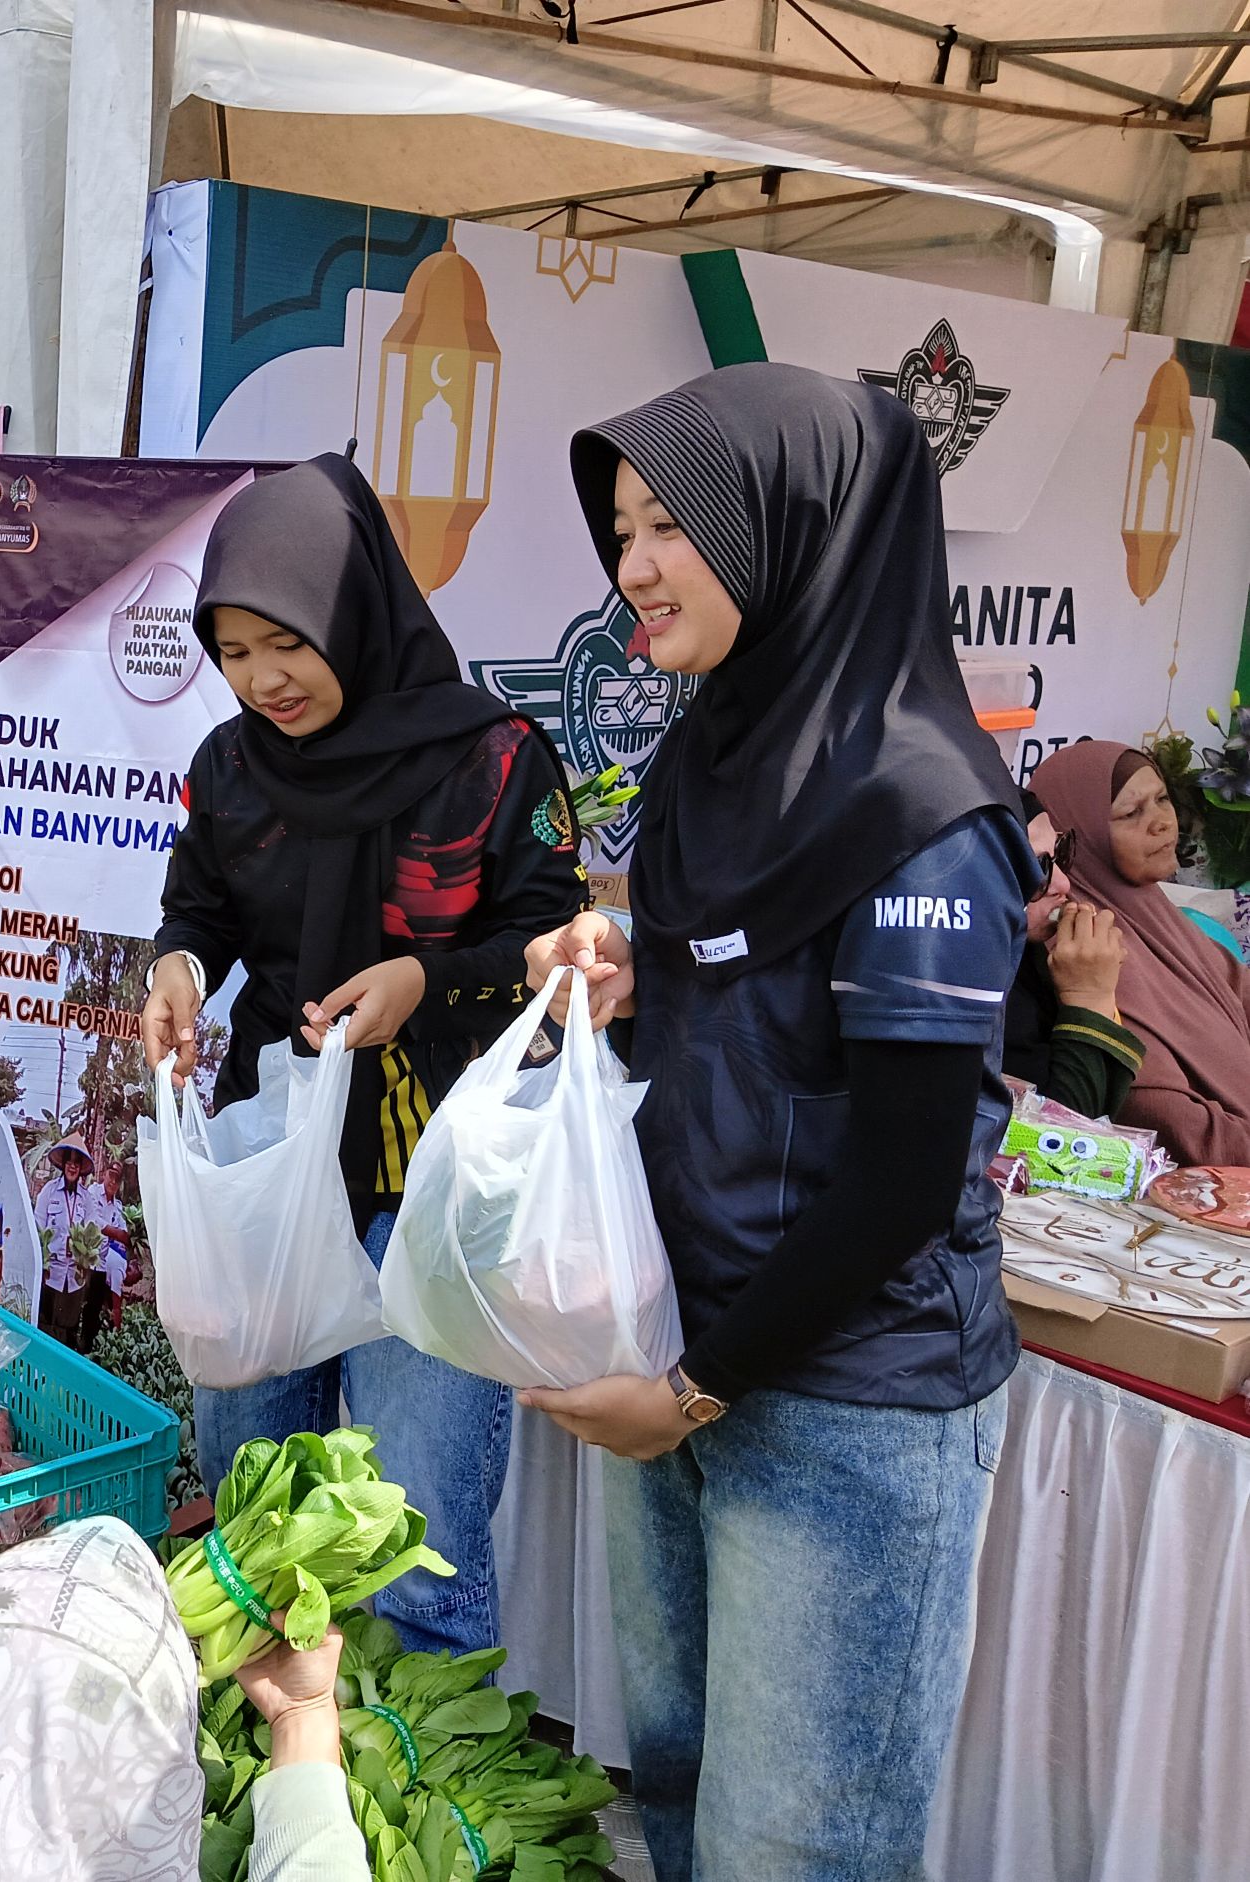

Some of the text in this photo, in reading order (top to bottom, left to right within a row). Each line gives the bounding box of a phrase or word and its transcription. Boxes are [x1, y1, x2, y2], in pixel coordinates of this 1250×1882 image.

[126, 605, 192, 624] HIJAUKAN
[950, 585, 1076, 646] ANITA
[124, 641, 188, 660] KUATKAN
[132, 623, 181, 643] RUTAN,
[126, 659, 182, 678] PANGAN
[572, 649, 598, 775] WANITA AL IRSYA
[124, 768, 184, 805] PAN
[31, 808, 177, 853] BANYUMA
[590, 879, 610, 889] BOX
[0, 907, 79, 945] MERAH
[874, 896, 971, 930] IMIPAS
[16, 996, 143, 1041] CALIFORNIA
